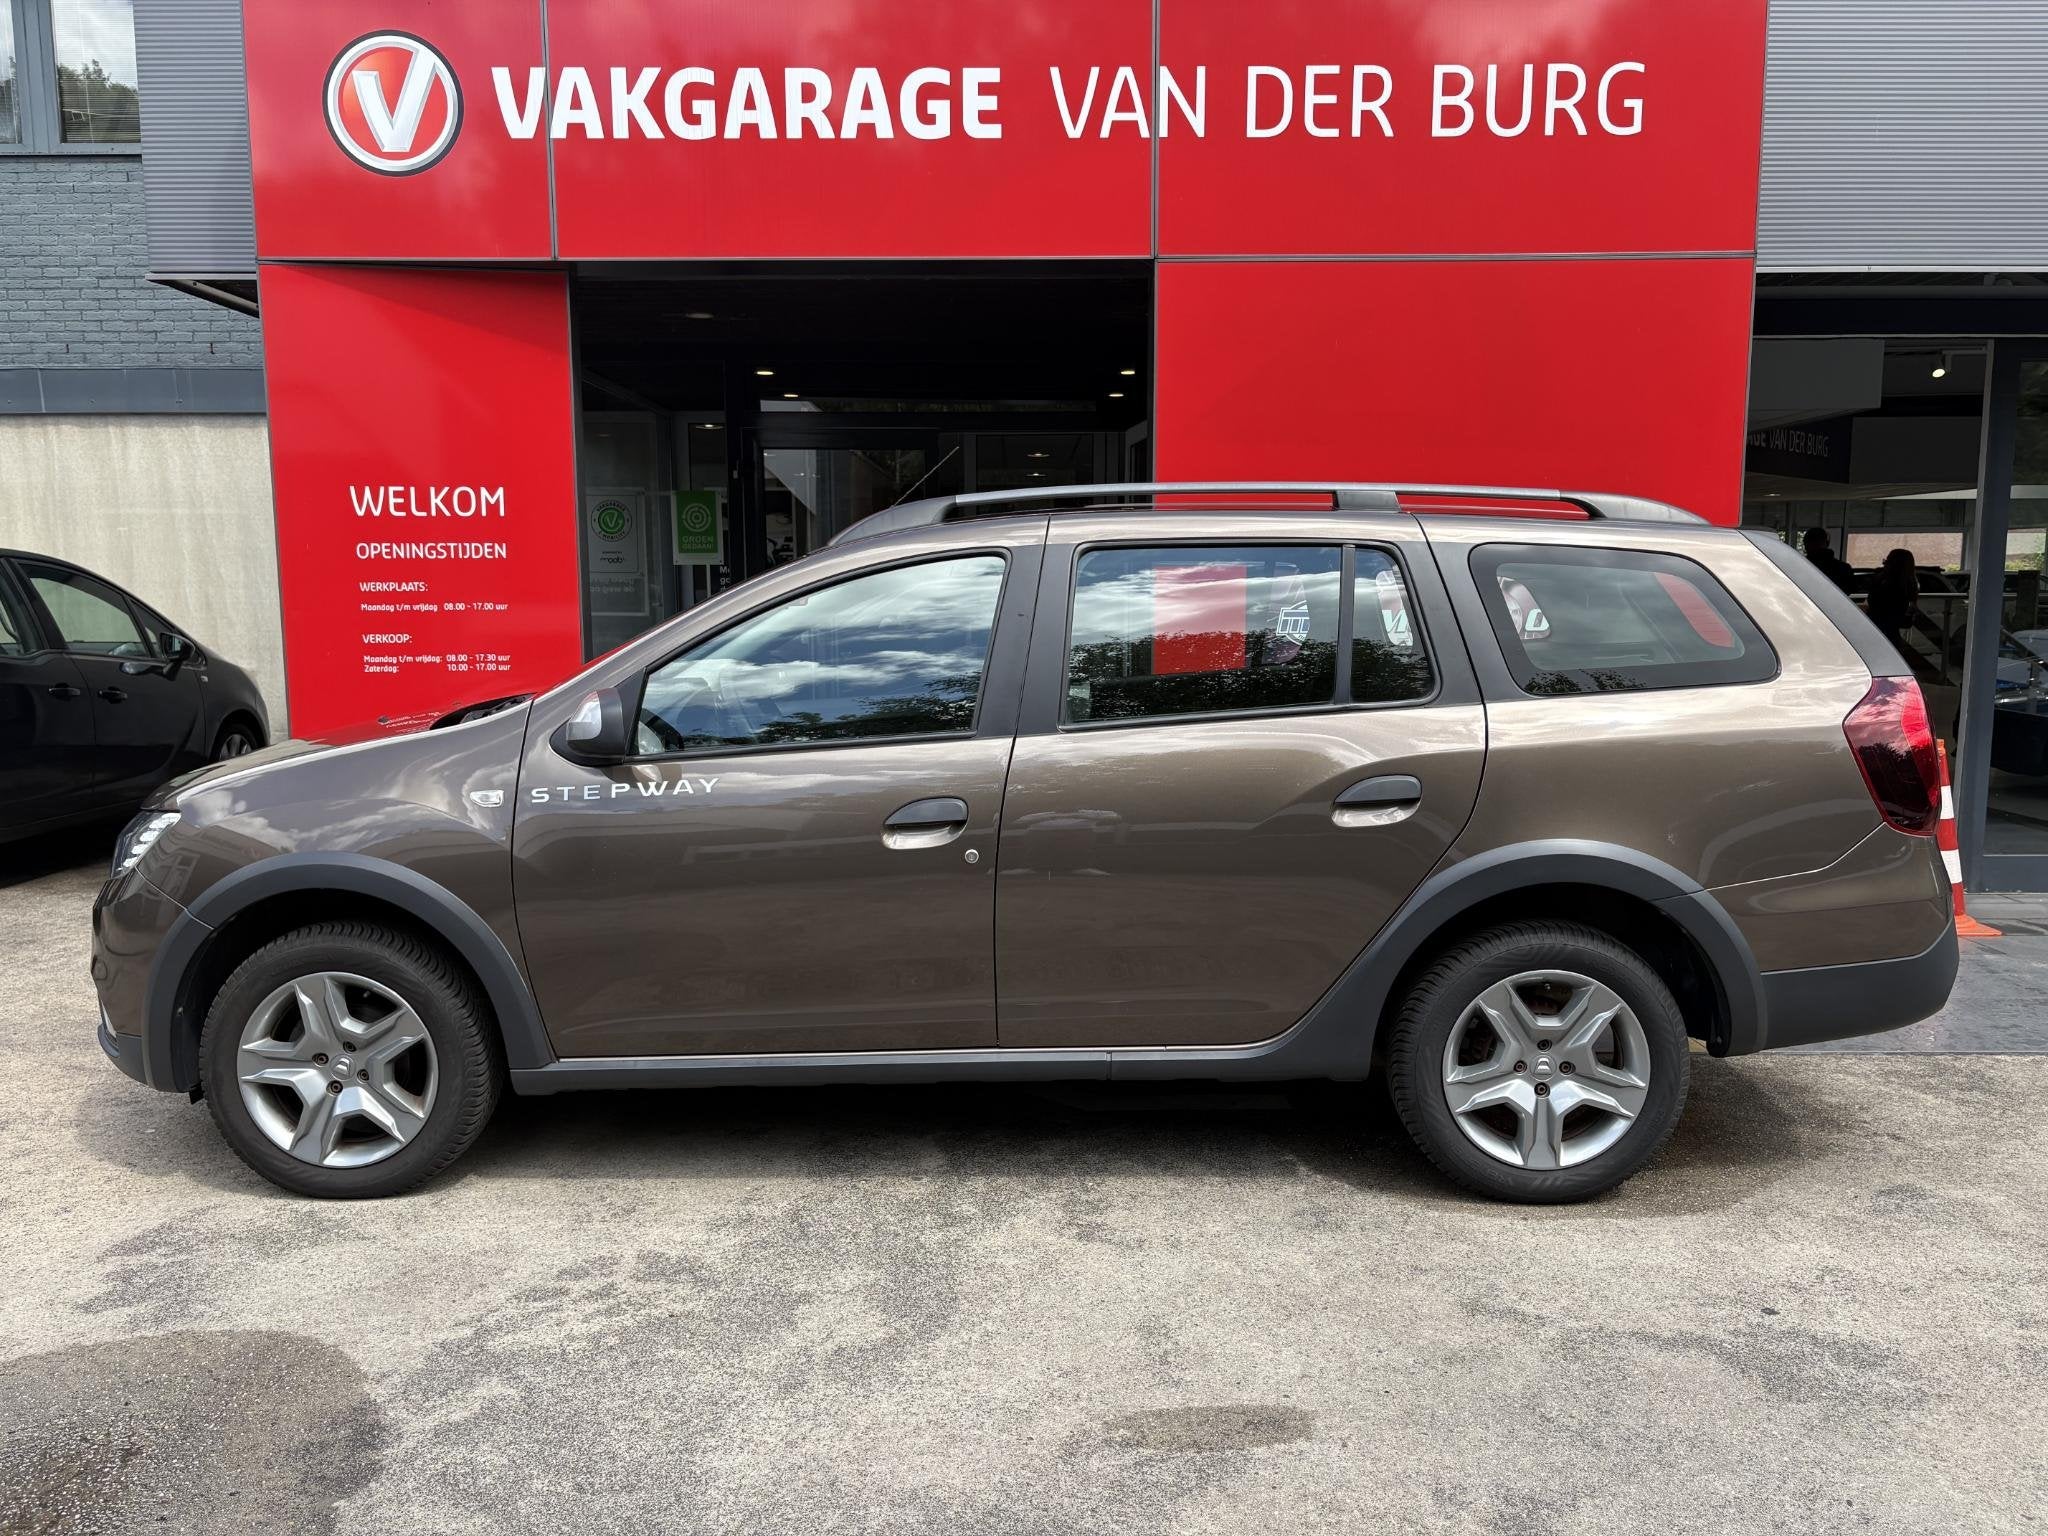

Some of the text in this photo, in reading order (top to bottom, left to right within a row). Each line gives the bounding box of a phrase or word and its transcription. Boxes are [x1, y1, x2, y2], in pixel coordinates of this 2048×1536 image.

[491, 62, 1646, 140] VAKGARAGE VAN DER BURG
[1789, 430, 1806, 453] DER
[1807, 433, 1829, 457] BURG
[350, 485, 505, 517] WELKOM
[356, 542, 507, 559] OPENINGSTIJDEN
[359, 581, 428, 592] WERKPLAATS:
[361, 604, 394, 612] Maandag
[412, 604, 438, 612] vrijdag
[443, 603, 466, 611] 08.00
[473, 602, 494, 610] 17.00
[362, 634, 413, 644] VERKOOP:
[364, 655, 397, 664] Maandag
[399, 655, 414, 663] t/m
[446, 654, 468, 662] 08.00
[364, 665, 400, 673] Zaterdag:
[475, 663, 496, 671] 17.00
[531, 777, 720, 803] STEPWAY
